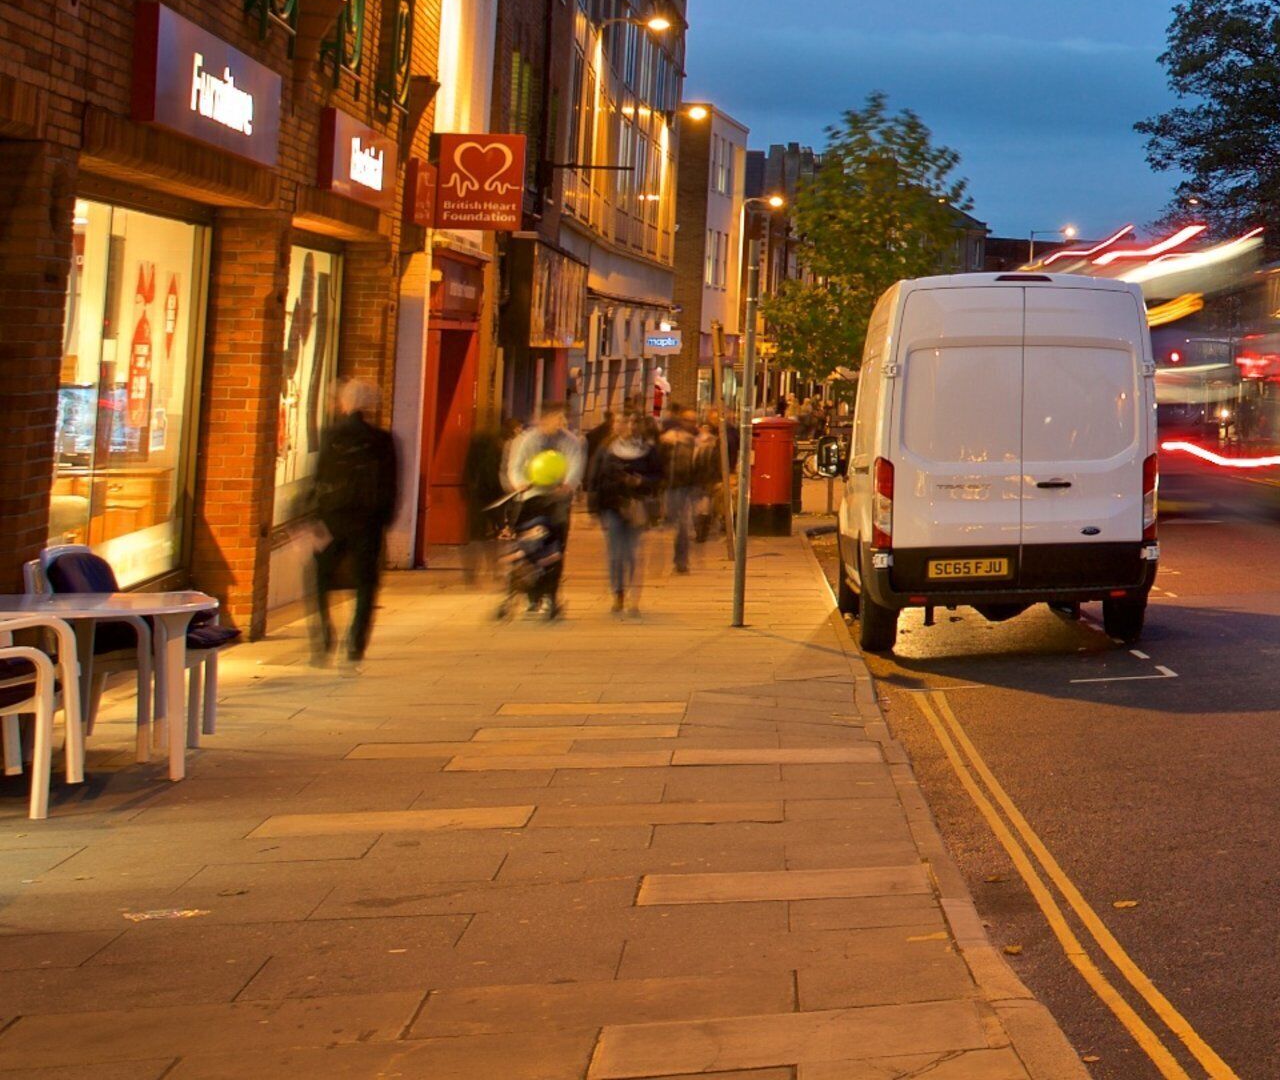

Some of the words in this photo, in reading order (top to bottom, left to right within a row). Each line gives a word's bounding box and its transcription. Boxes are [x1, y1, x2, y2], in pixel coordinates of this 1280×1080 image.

[443, 200, 482, 210] British
[483, 201, 517, 211] Heart
[442, 211, 517, 222] Foundation
[934, 562, 971, 575] SC65
[975, 561, 1002, 574] FJU
